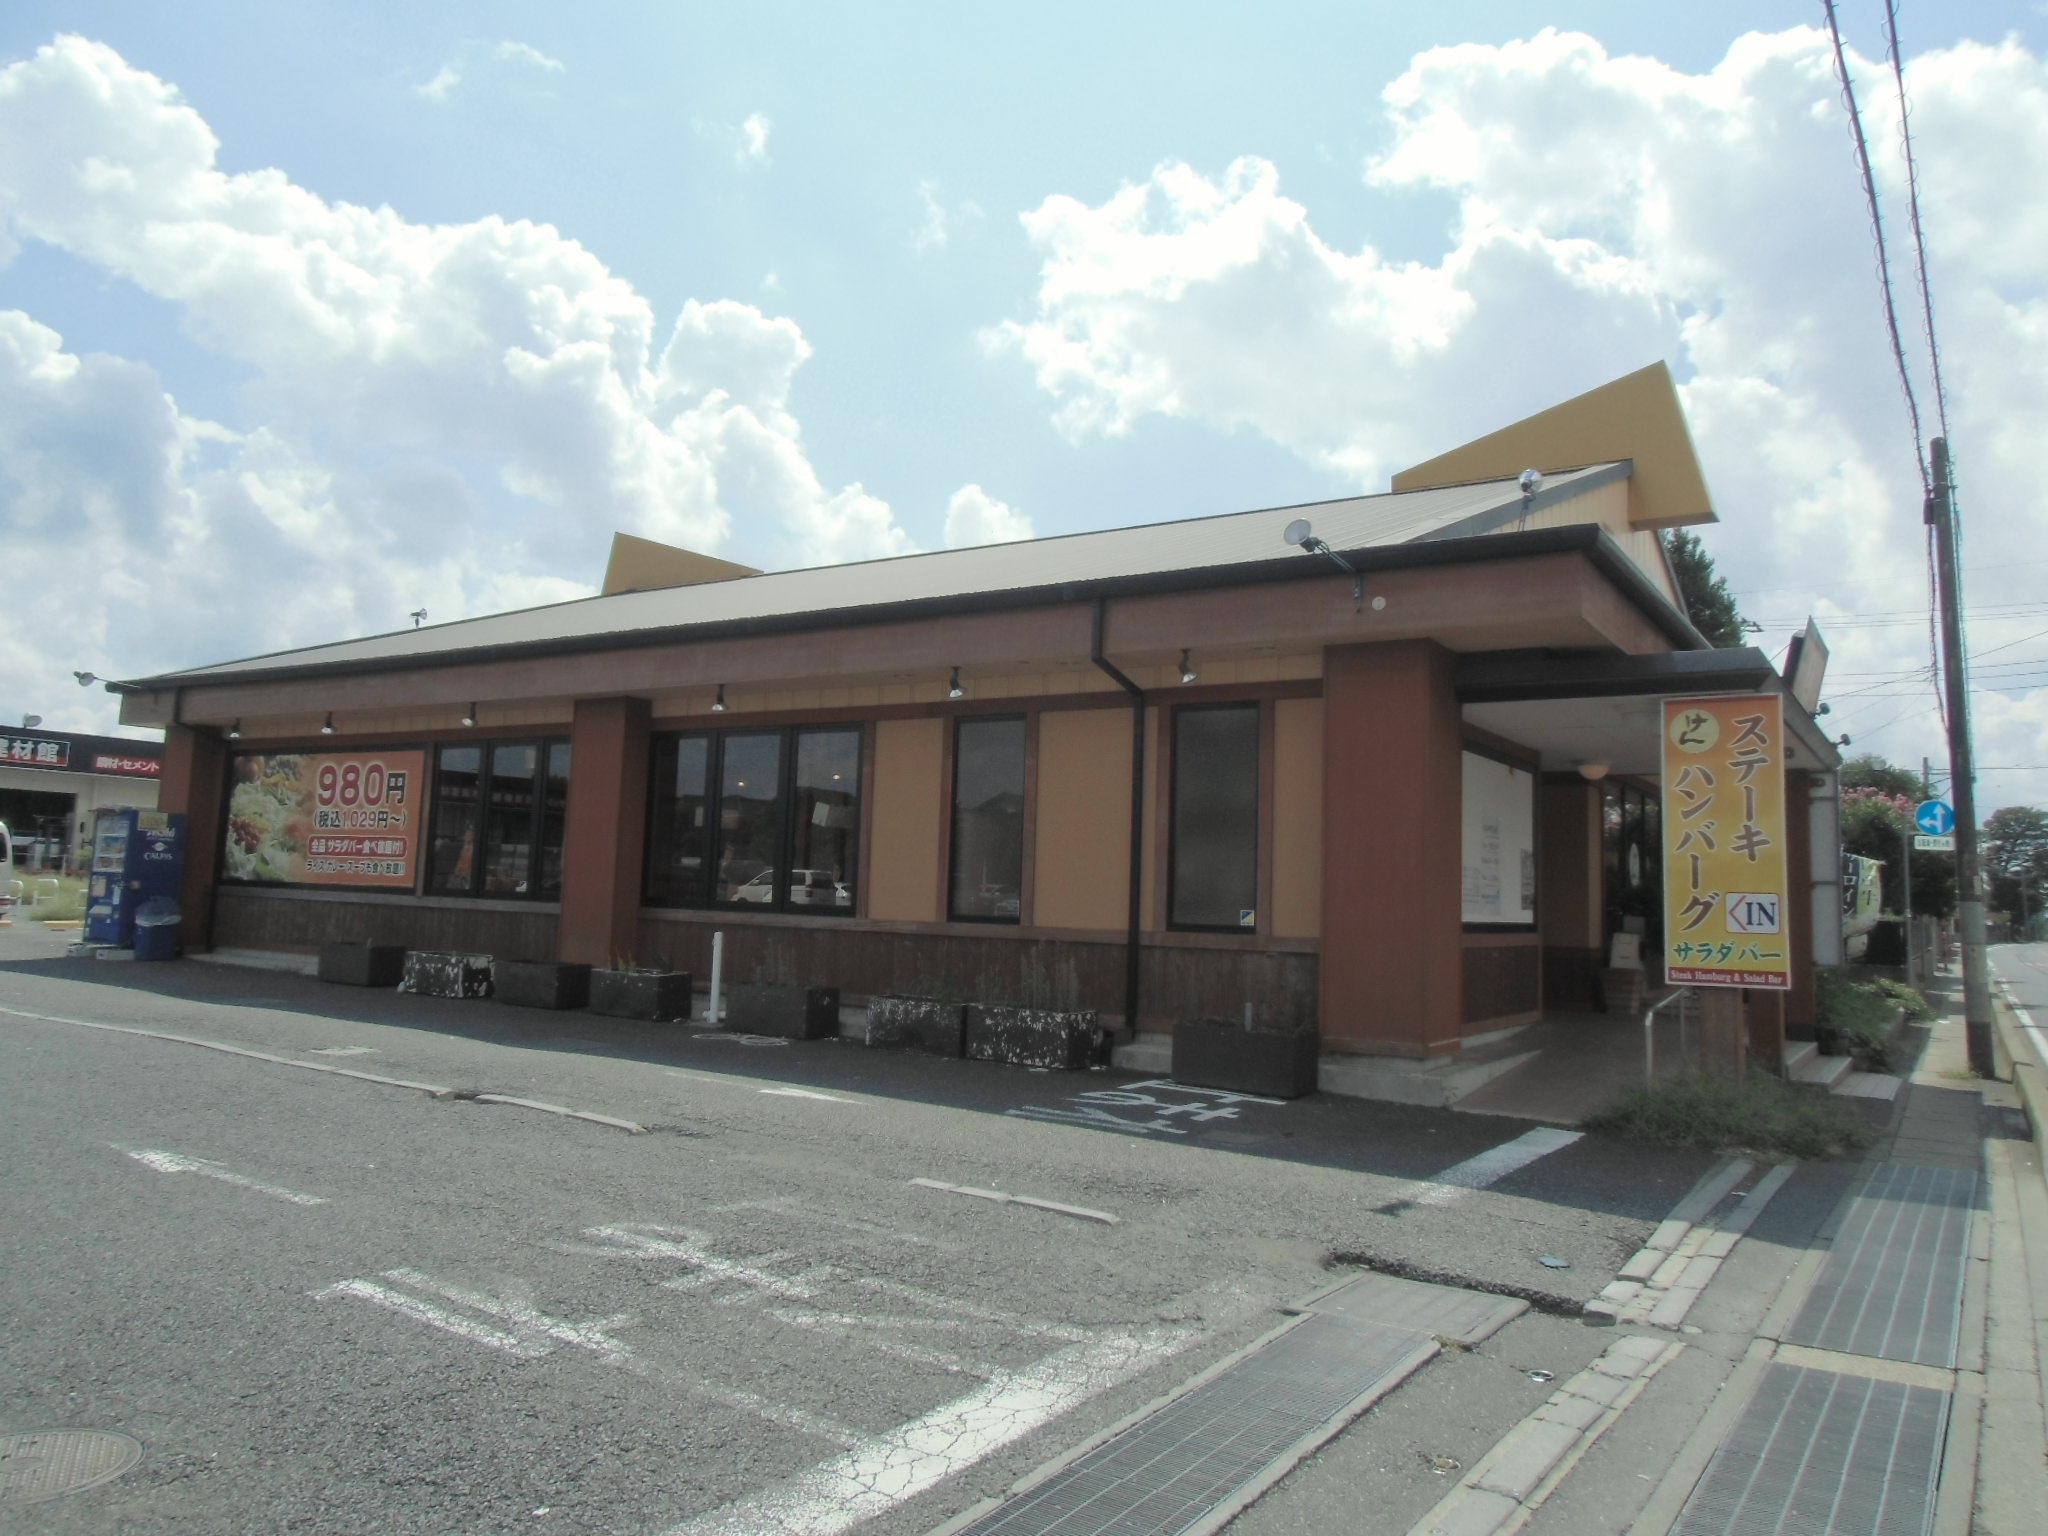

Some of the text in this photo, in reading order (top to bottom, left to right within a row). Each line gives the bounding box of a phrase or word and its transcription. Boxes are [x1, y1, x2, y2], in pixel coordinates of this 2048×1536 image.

[1679, 715, 1708, 746] けん
[1730, 715, 1771, 861] ステーキ
[1675, 766, 1720, 931] ハンバーグ
[1745, 901, 1777, 926] IN
[1671, 970, 1783, 984] Steak Hamburg & Salad Bar
